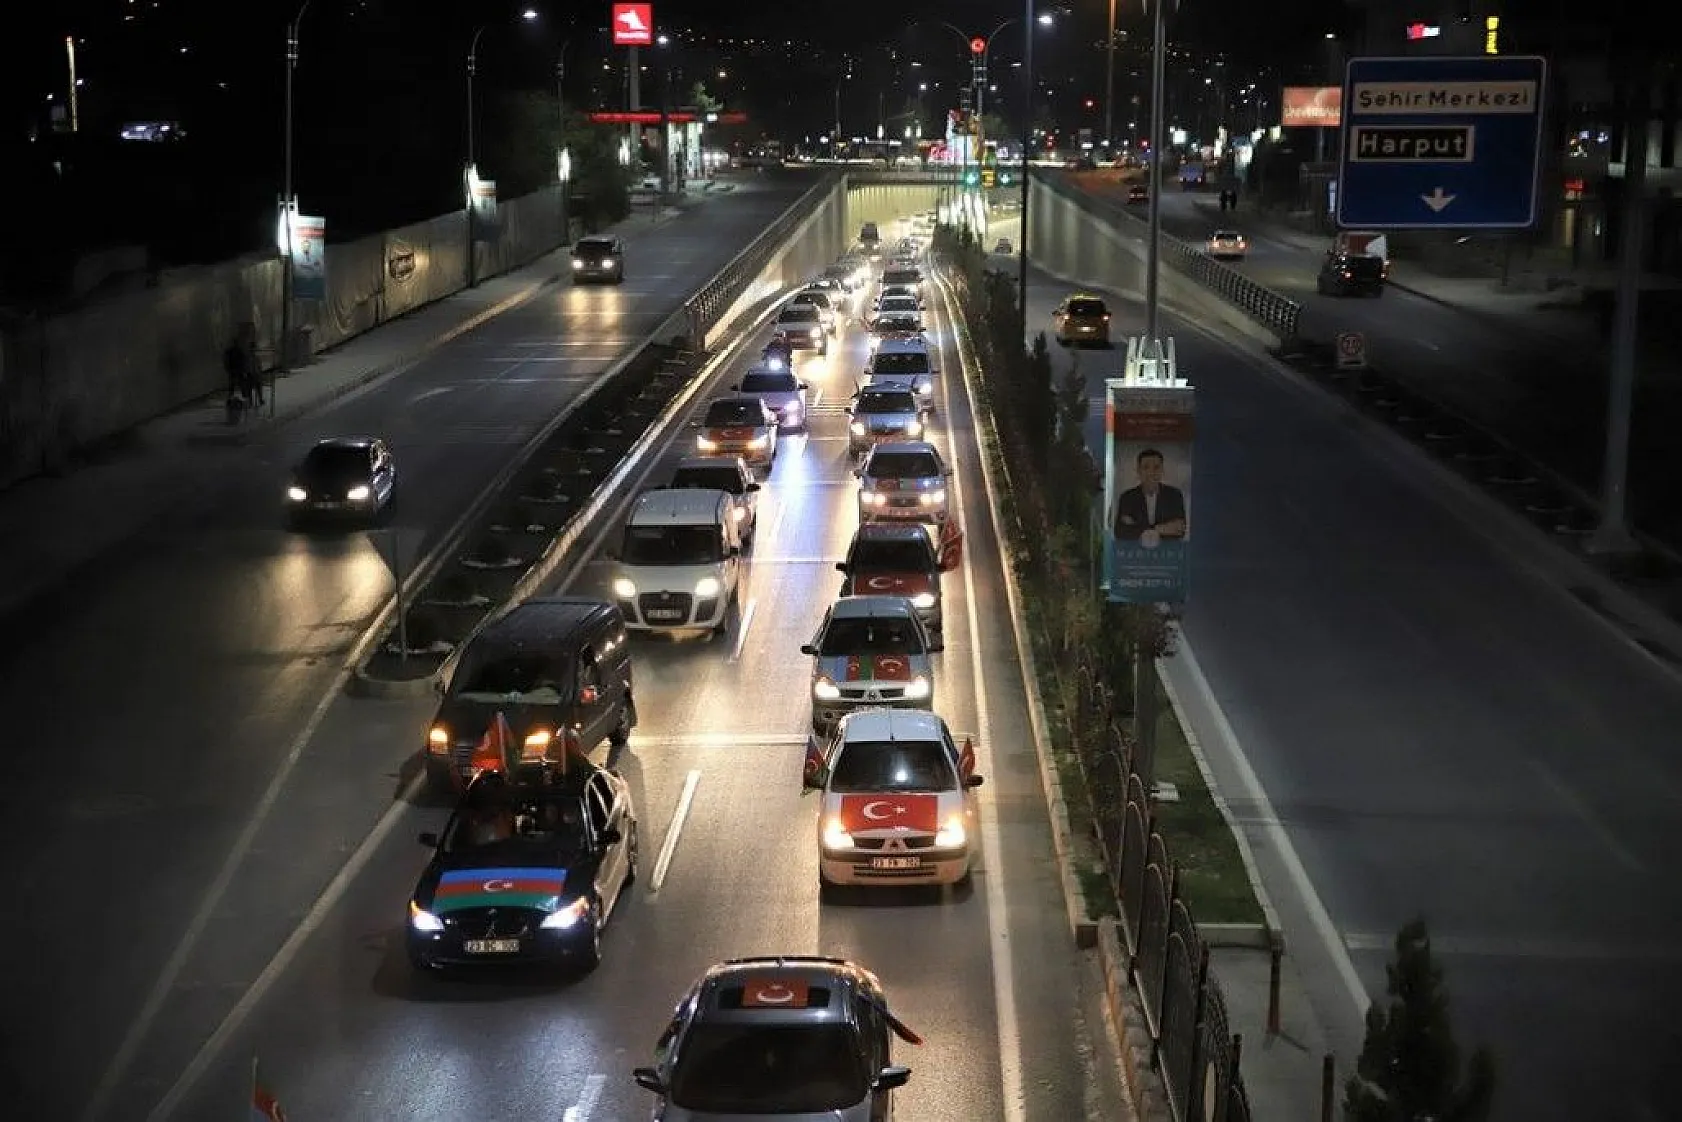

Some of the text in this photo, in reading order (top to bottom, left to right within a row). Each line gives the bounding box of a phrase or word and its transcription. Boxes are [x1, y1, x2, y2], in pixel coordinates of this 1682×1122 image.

[1359, 88, 1529, 108] Şehir Merkezi
[1360, 133, 1465, 158] Harput
